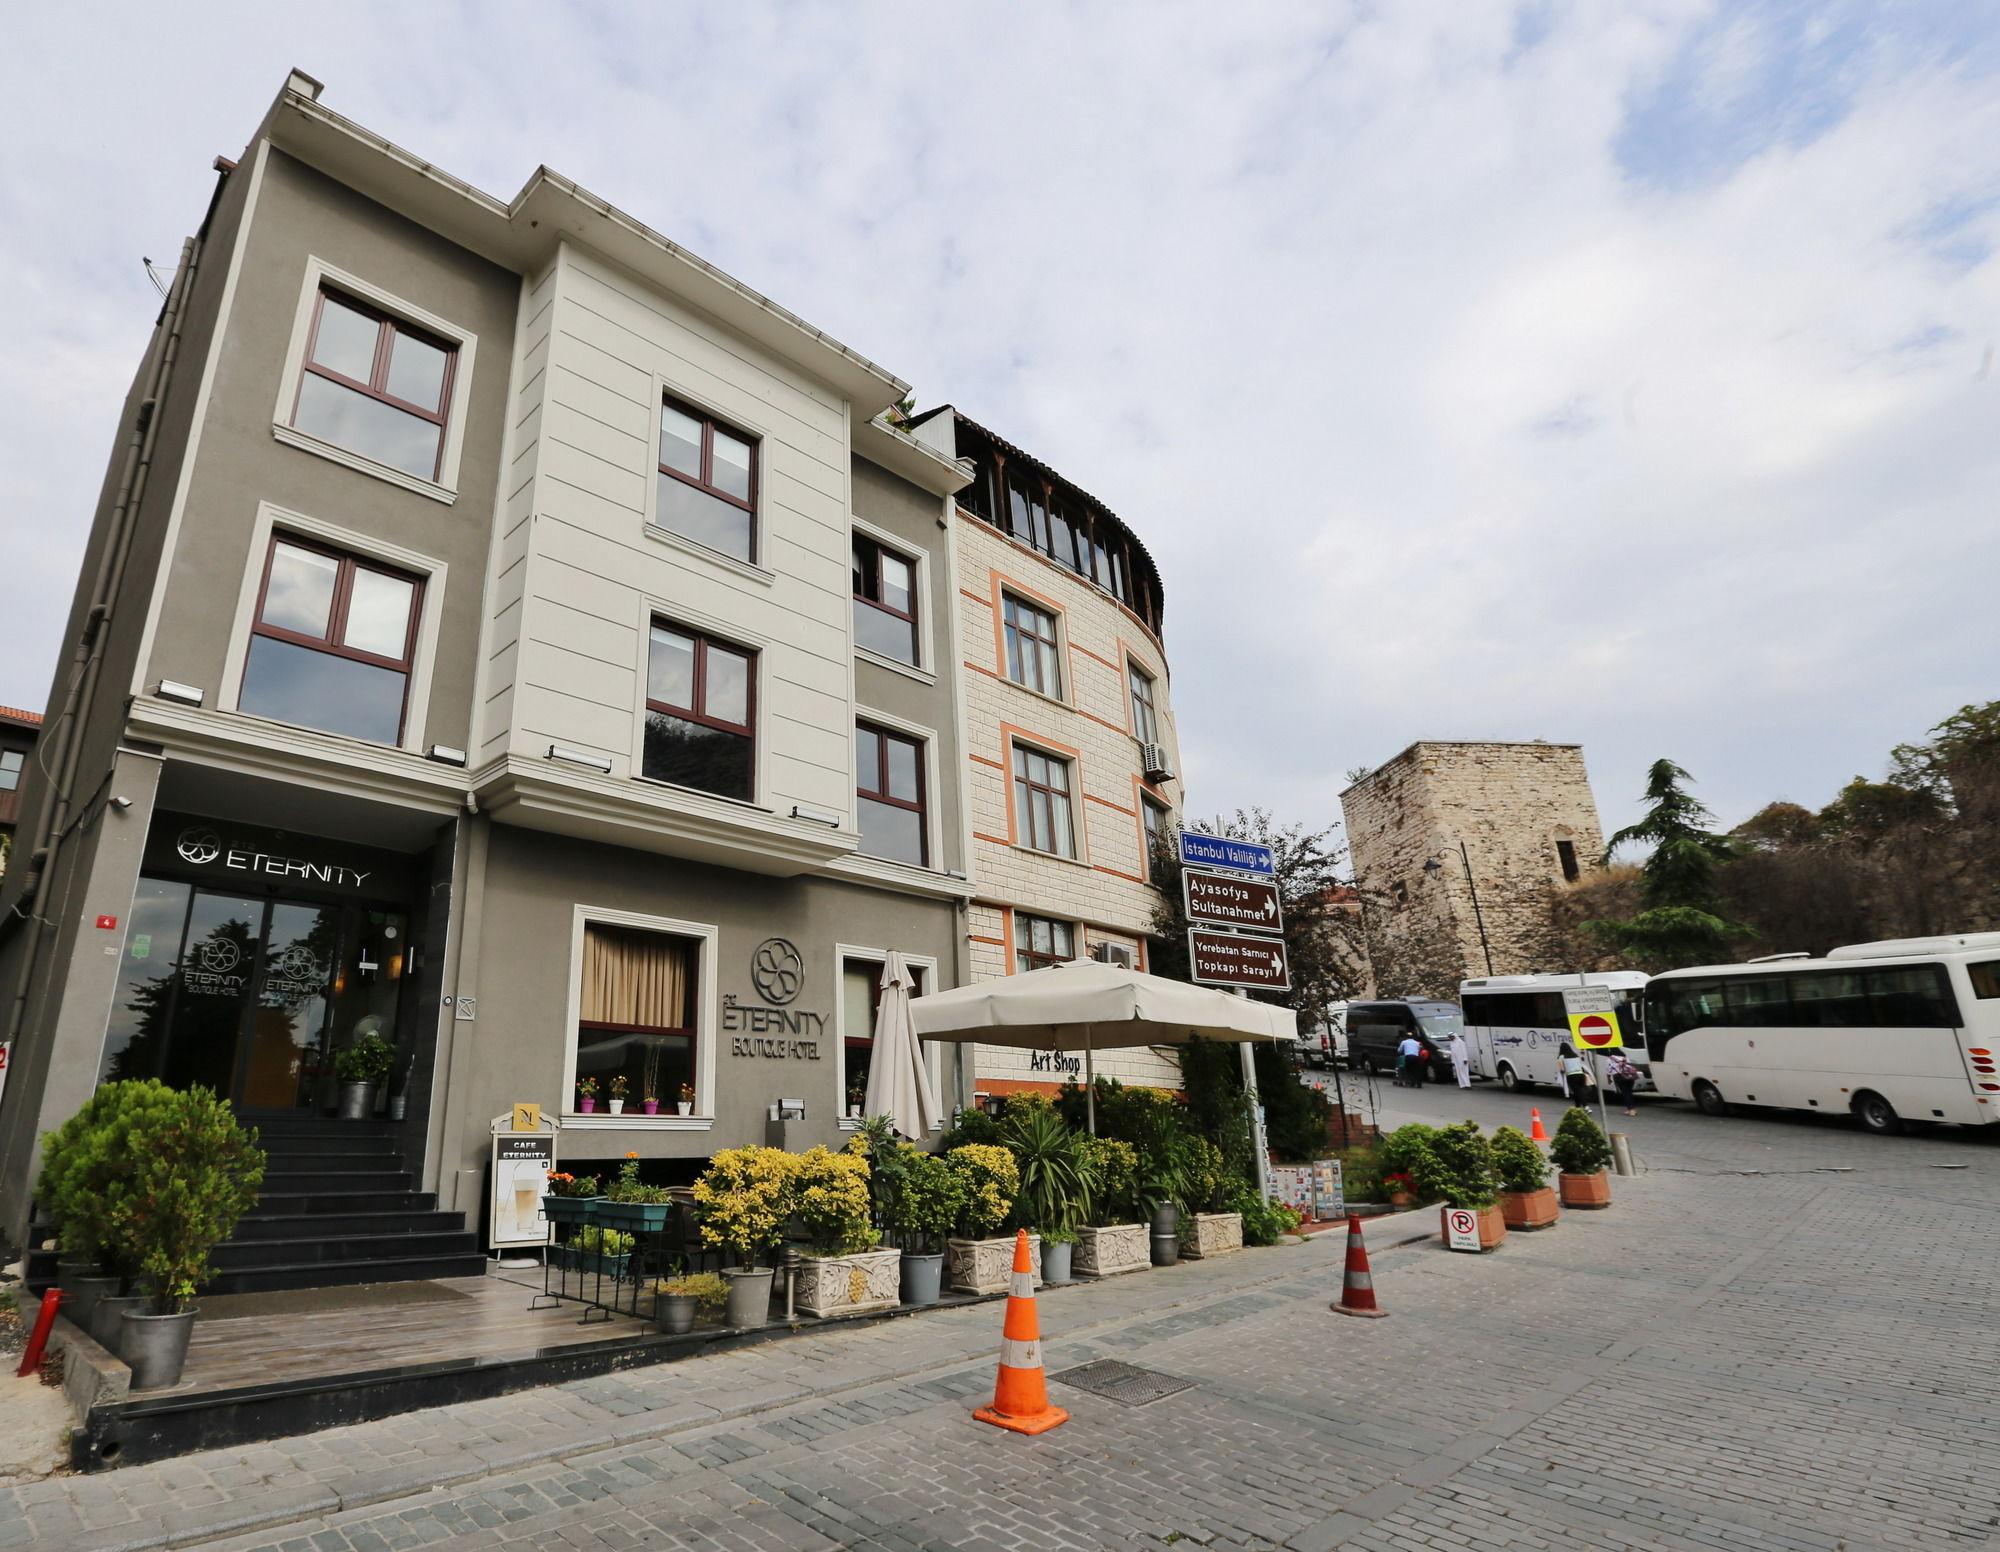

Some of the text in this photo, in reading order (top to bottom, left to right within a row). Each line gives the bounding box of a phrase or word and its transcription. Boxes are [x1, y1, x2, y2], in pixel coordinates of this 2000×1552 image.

[1184, 836, 1257, 868] İstanbul Valiliği
[226, 850, 371, 887] ETERNITY
[1190, 879, 1249, 901] Ayasofya
[1191, 899, 1266, 921] Sultanahmet
[1196, 941, 1269, 959] Yerebatan Sarnıcı
[184, 971, 248, 988] ETERNITY
[1197, 959, 1273, 978] Topkapı Sarayı
[722, 1004, 830, 1036] ETERNITY
[732, 1037, 821, 1060] BOUTIQUE HOTEL
[1031, 1050, 1080, 1075] Art Shop
